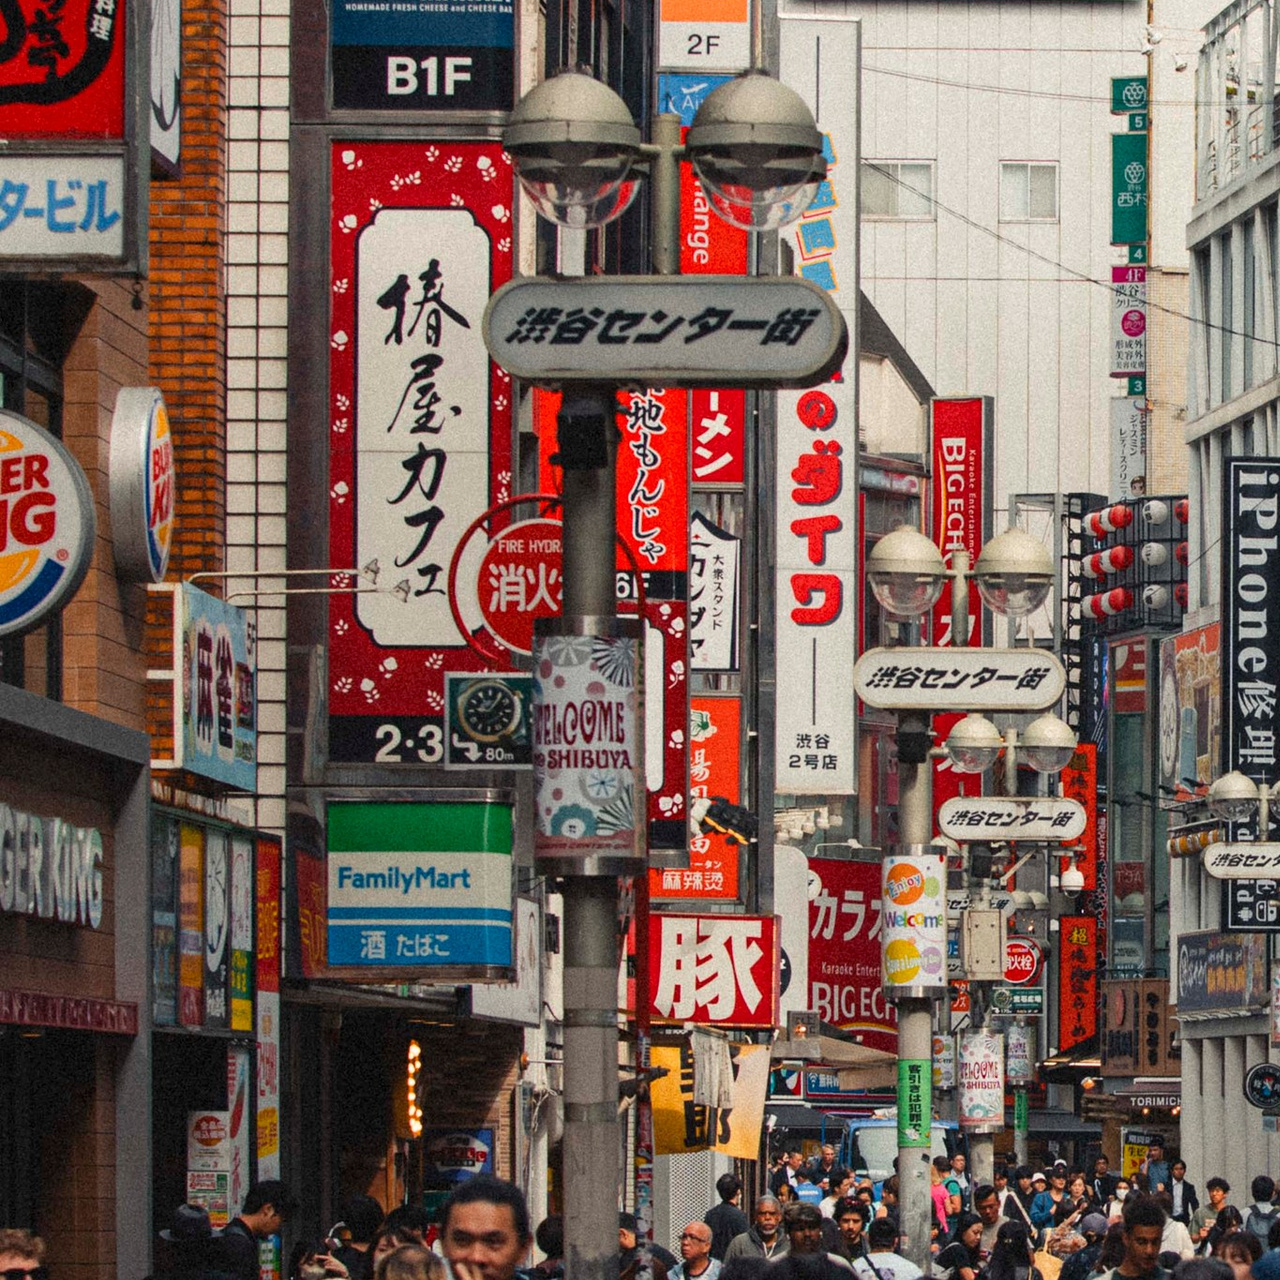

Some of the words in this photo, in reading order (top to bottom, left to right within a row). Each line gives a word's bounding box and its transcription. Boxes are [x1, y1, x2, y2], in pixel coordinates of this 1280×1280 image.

[686, 34, 720, 56] 2F
[386, 56, 473, 96] B1F
[505, 307, 820, 348] 渋谷センター街
[377, 259, 470, 598] 椿屋カフェ
[941, 437, 966, 493] BIG
[946, 498, 963, 563] ECH
[498, 539, 525, 554] FIRE
[528, 539, 563, 554] HYDR
[487, 561, 563, 613] 消火
[865, 666, 1052, 691] 渋谷センター街
[534, 701, 625, 746] WELCOME
[796, 732, 831, 750] 渋谷
[485, 747, 515, 762] 80m
[547, 748, 632, 770] SHIBUYA
[788, 754, 838, 771] 2号店
[946, 809, 1076, 830] 渋谷センター街
[337, 866, 471, 894] FamilyMart
[887, 873, 923, 898] Enjoy
[885, 910, 943, 929] Welcome
[360, 930, 387, 960] 酒
[395, 932, 451, 957] たばこ
[654, 916, 764, 1021] 豚
[822, 961, 853, 975] Karaoke
[856, 964, 881, 977] Entert
[812, 981, 856, 1022] BIG
